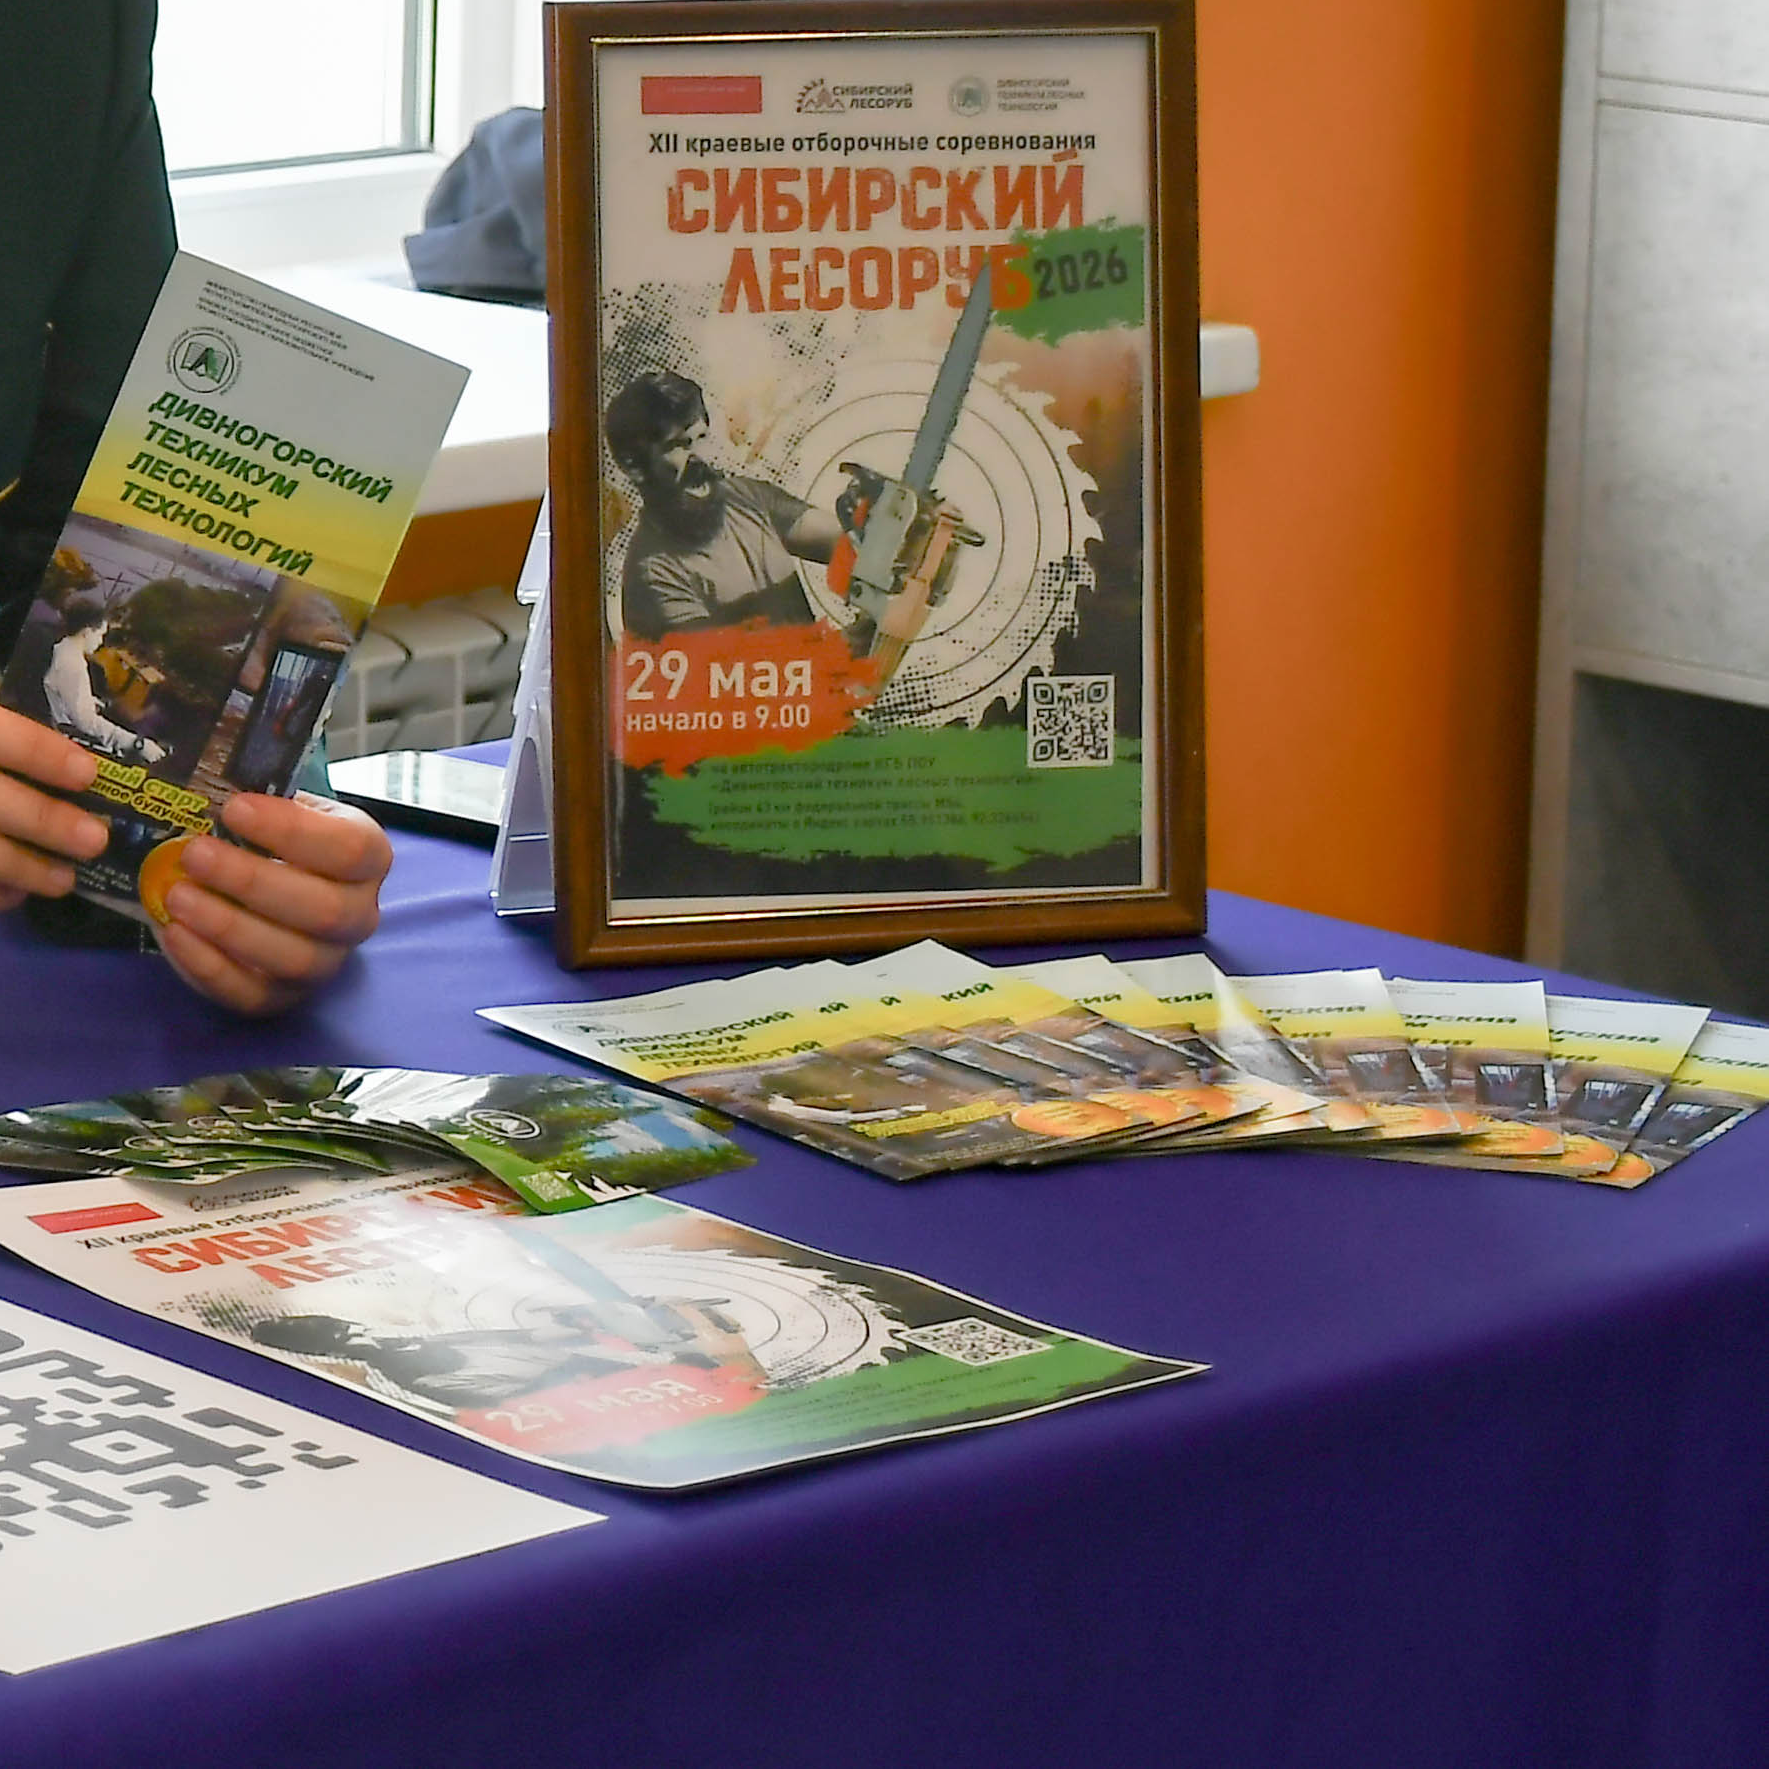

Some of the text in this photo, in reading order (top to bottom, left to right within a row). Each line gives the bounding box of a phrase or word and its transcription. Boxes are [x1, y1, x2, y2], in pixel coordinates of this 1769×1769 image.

[832, 82, 913, 97] СИБИРСКИЙ
[849, 98, 913, 110] ЛЕСОРУБ
[685, 135, 786, 158] краевые
[791, 132, 929, 156] отборочные
[936, 133, 1097, 156] соревнования
[666, 148, 1085, 235] СИБИРСКИЙ
[718, 243, 1033, 315] ЛЕСОРУБ
[1033, 245, 1129, 302] 2026
[143, 420, 300, 501] ТЕХНИКУМ
[148, 390, 394, 504] ДИВНОГОРСКИЙ
[126, 451, 262, 519] ЛЕСНЫХ
[118, 480, 314, 576] ТЕХНОЛОГИЙ
[624, 649, 813, 702] 29 мая
[625, 704, 811, 735] начало в 9.00
[132, 794, 211, 831] будущее!
[596, 1010, 795, 1048] ДИВНОГОРСКИЙ
[618, 1033, 748, 1054] ТЕХНИКУМ
[636, 1045, 745, 1062] ЛЕСНЫХ
[660, 1040, 824, 1070] ТЕХНОЛОГИЙ
[118, 1221, 213, 1245] краевые
[215, 1196, 347, 1228] отборочные
[485, 1404, 566, 1433] 29
